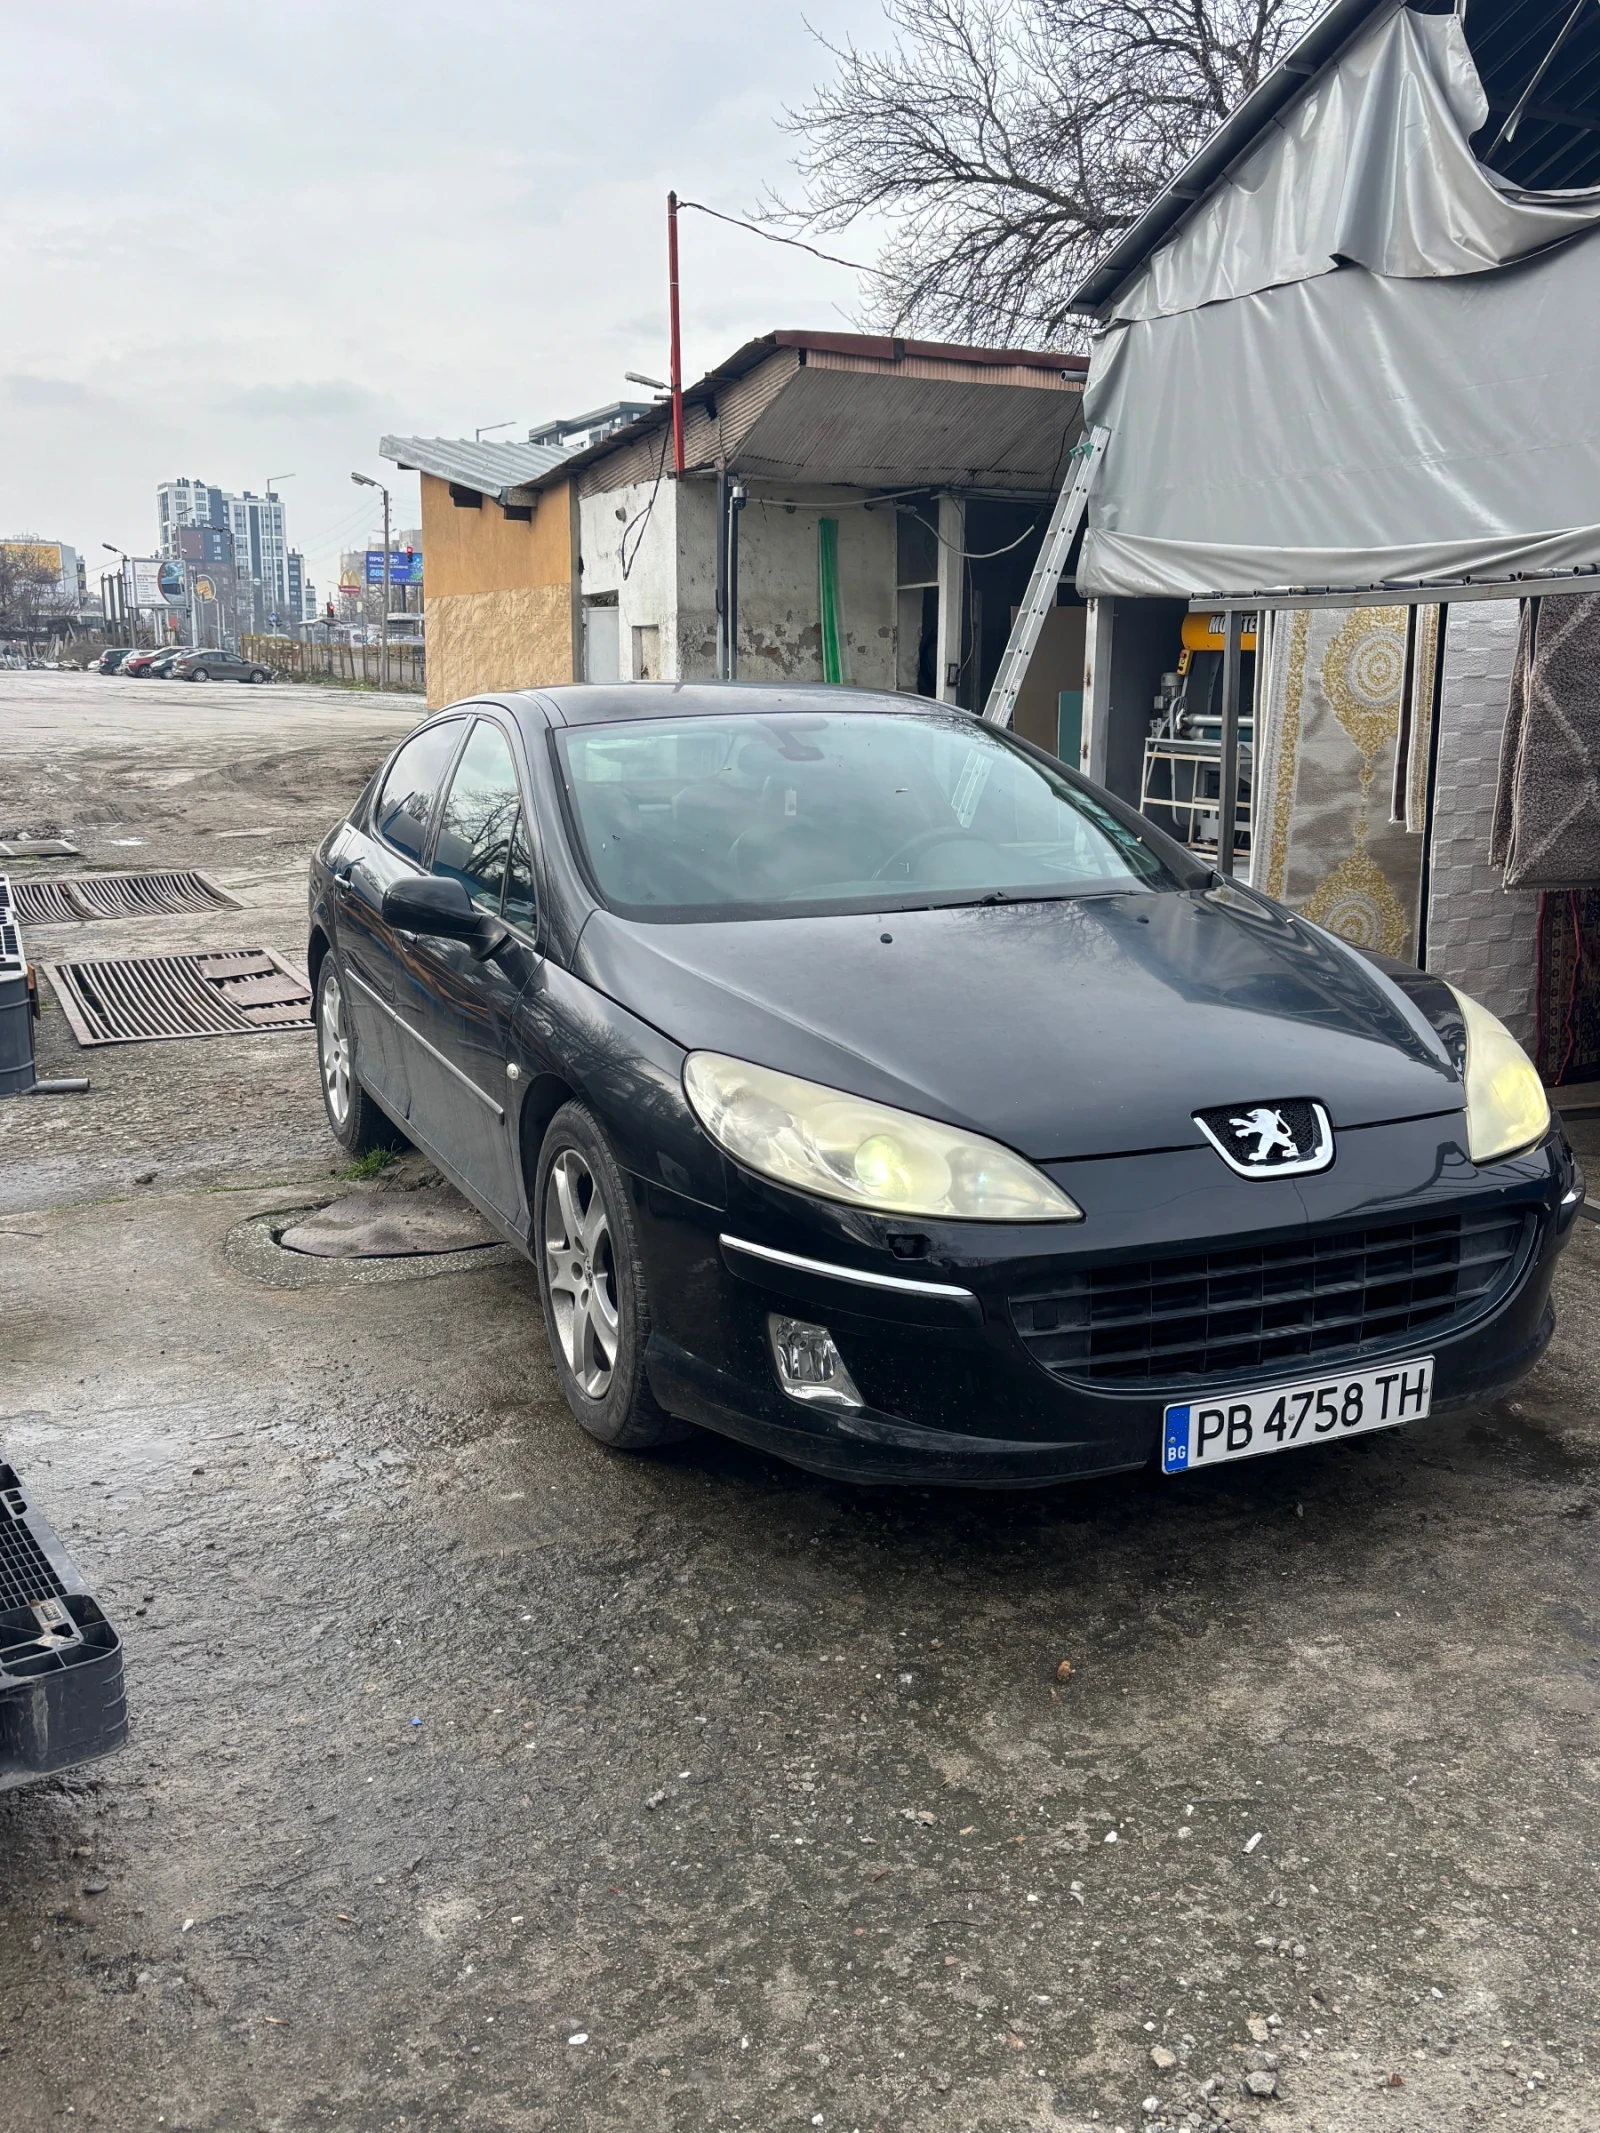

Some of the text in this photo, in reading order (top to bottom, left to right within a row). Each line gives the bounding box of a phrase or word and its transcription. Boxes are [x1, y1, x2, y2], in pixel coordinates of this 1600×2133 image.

[1196, 1368, 1426, 1458] PB 4758 TH
[1167, 1445, 1187, 1462] BG
